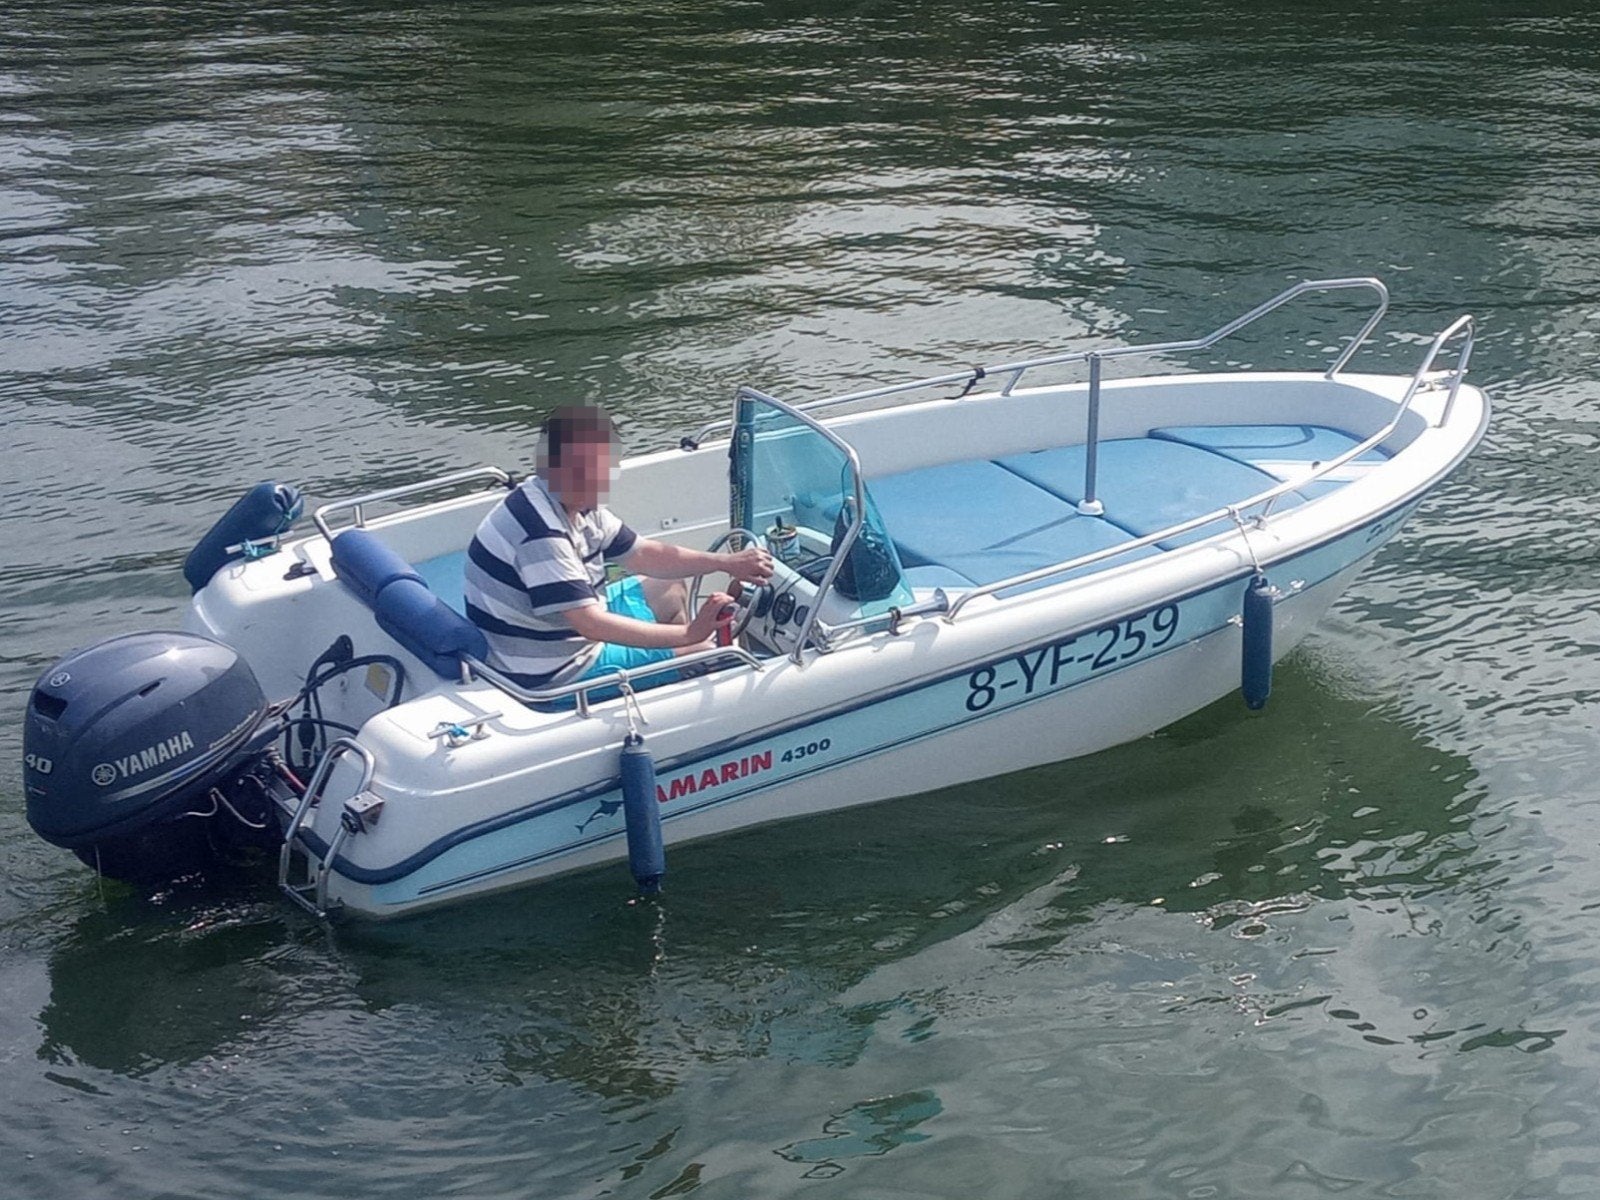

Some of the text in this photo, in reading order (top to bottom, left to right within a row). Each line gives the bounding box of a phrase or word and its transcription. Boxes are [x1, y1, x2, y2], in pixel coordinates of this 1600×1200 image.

[965, 602, 1179, 712] 8-YF-259
[25, 754, 52, 774] 40
[115, 730, 194, 777] YAMAHA
[780, 738, 831, 763] 4300
